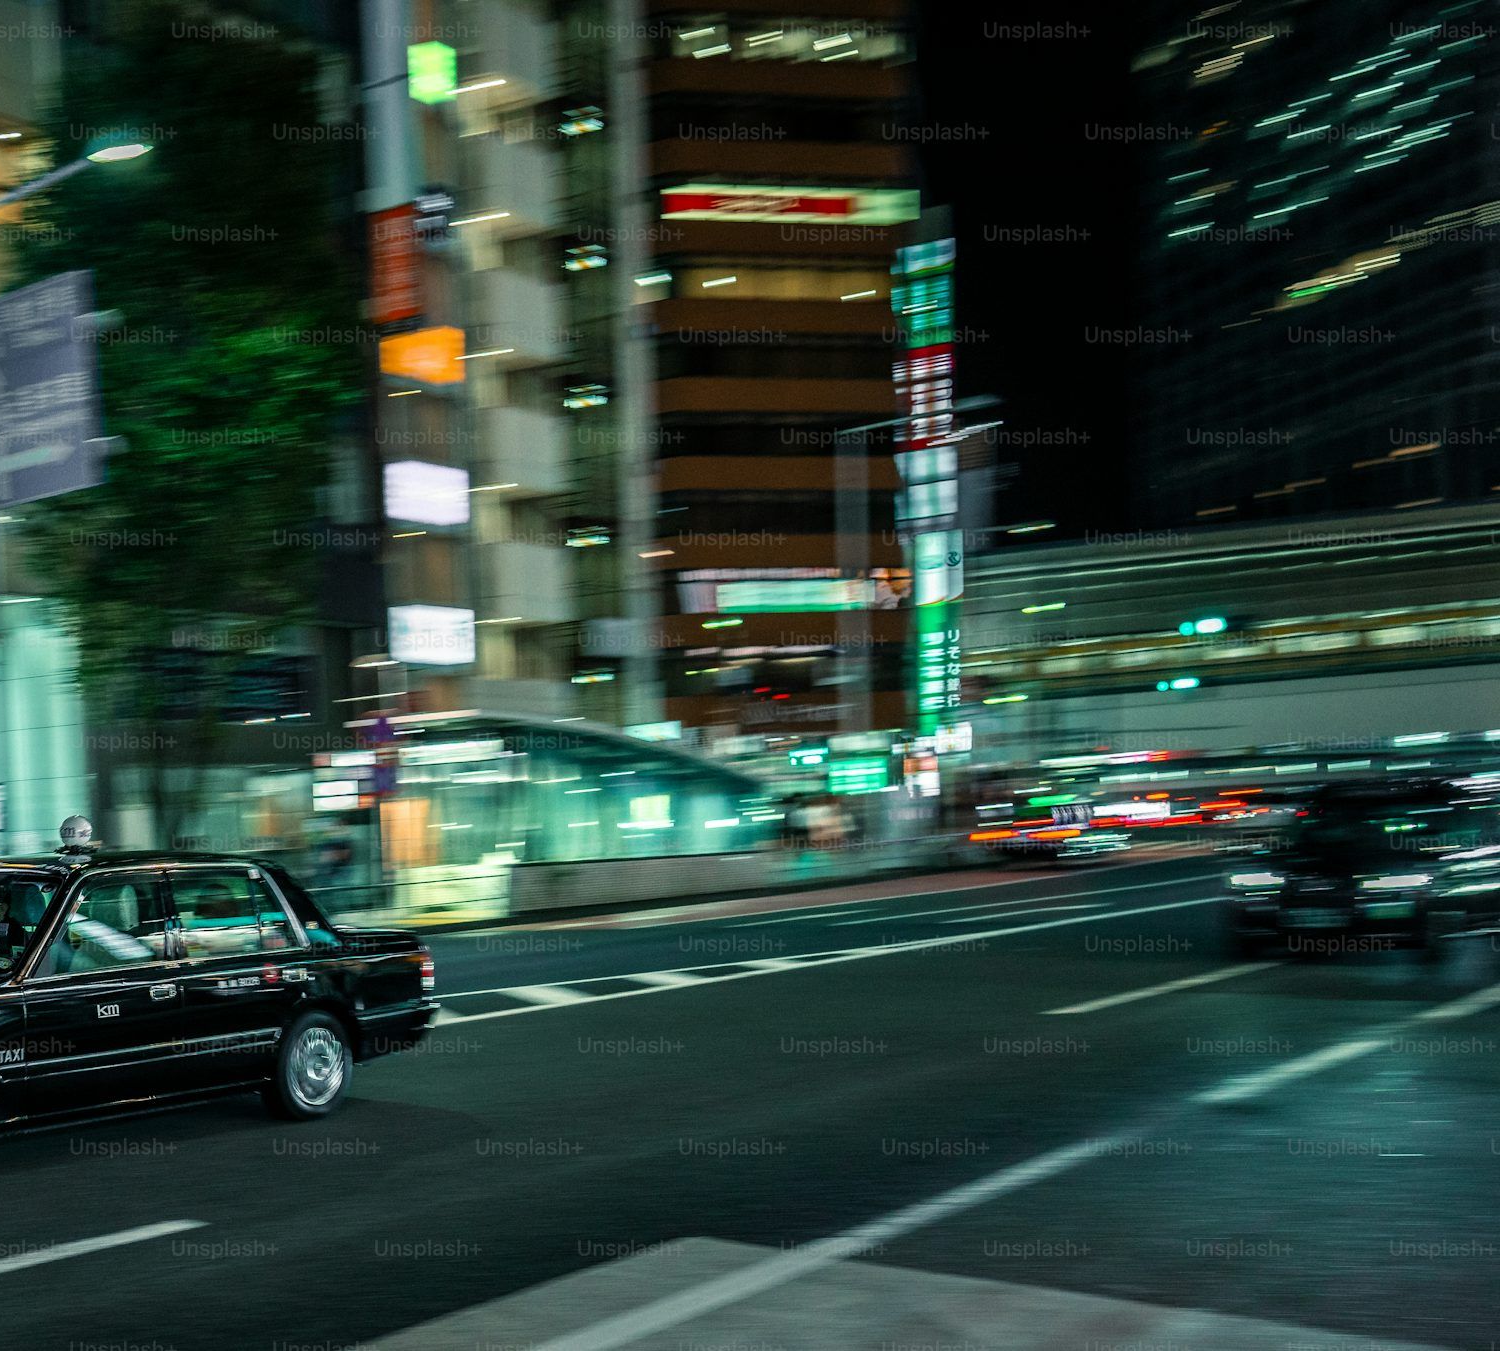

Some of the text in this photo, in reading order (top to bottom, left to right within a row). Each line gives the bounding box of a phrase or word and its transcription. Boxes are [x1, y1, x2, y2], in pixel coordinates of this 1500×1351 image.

[947, 629, 961, 707] りそな銀行
[97, 1004, 120, 1018] km
